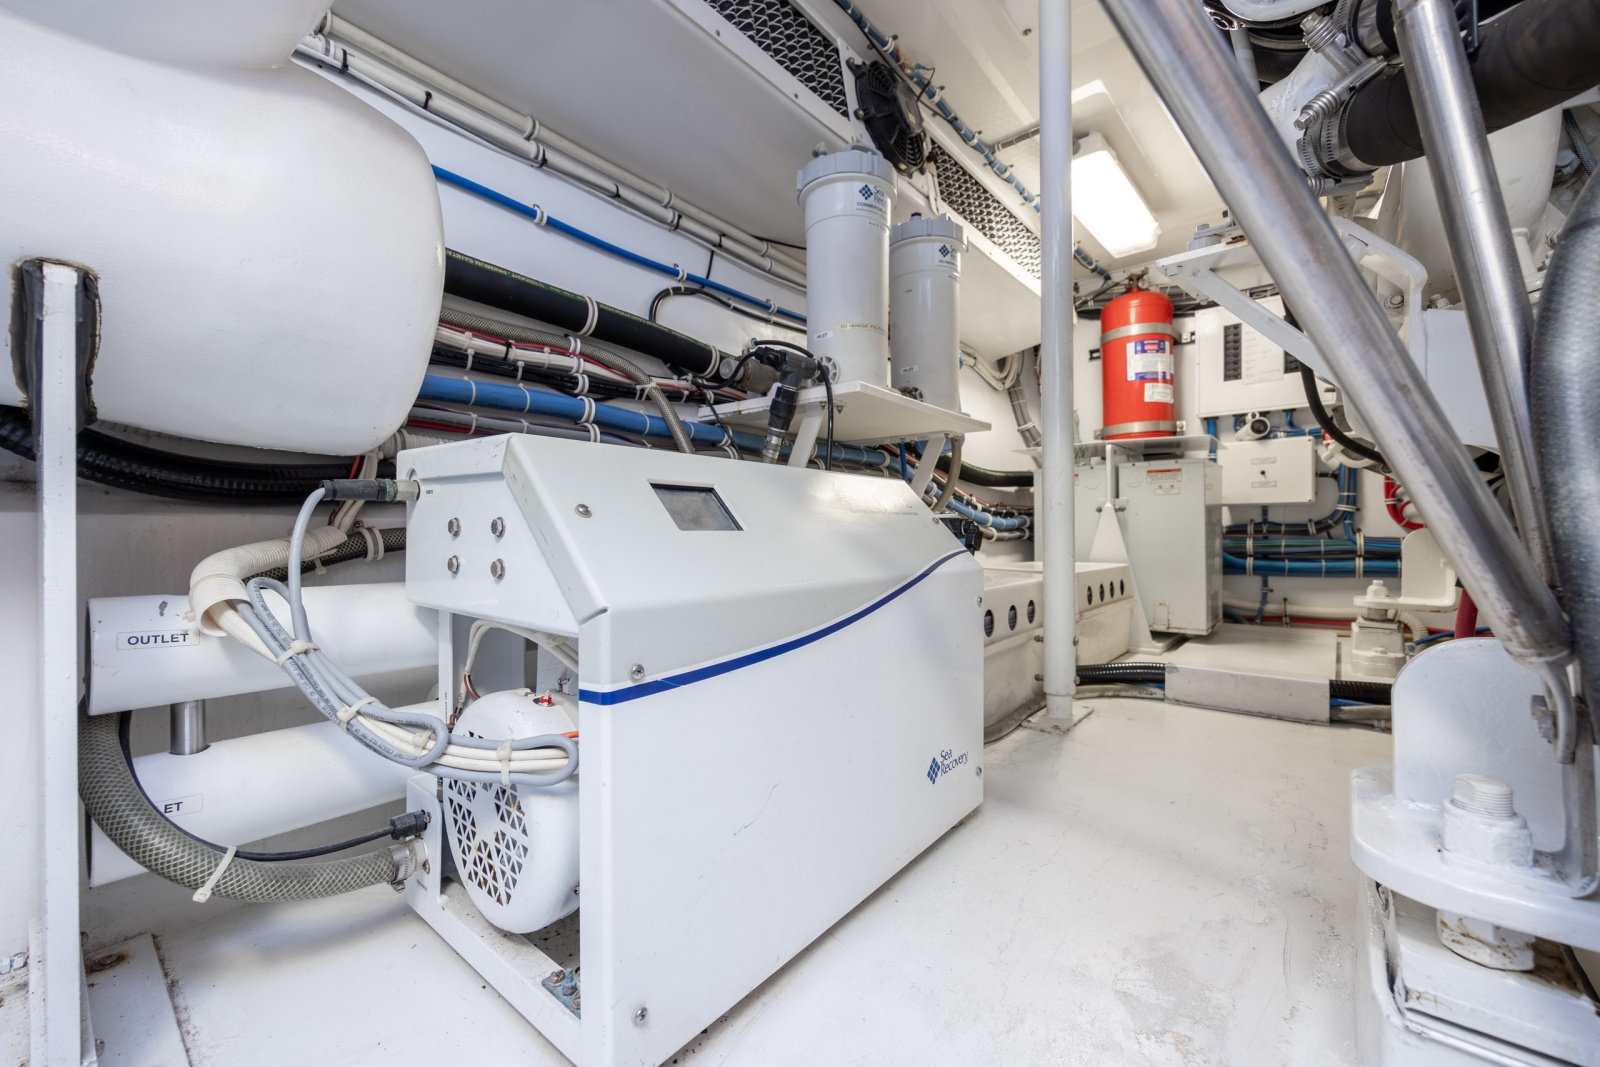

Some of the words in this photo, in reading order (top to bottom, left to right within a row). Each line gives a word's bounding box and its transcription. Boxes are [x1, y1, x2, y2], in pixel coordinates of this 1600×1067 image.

[816, 332, 829, 340] INLET
[127, 633, 189, 646] OUTLET
[940, 749, 952, 761] Sea
[940, 751, 968, 777] Recovery
